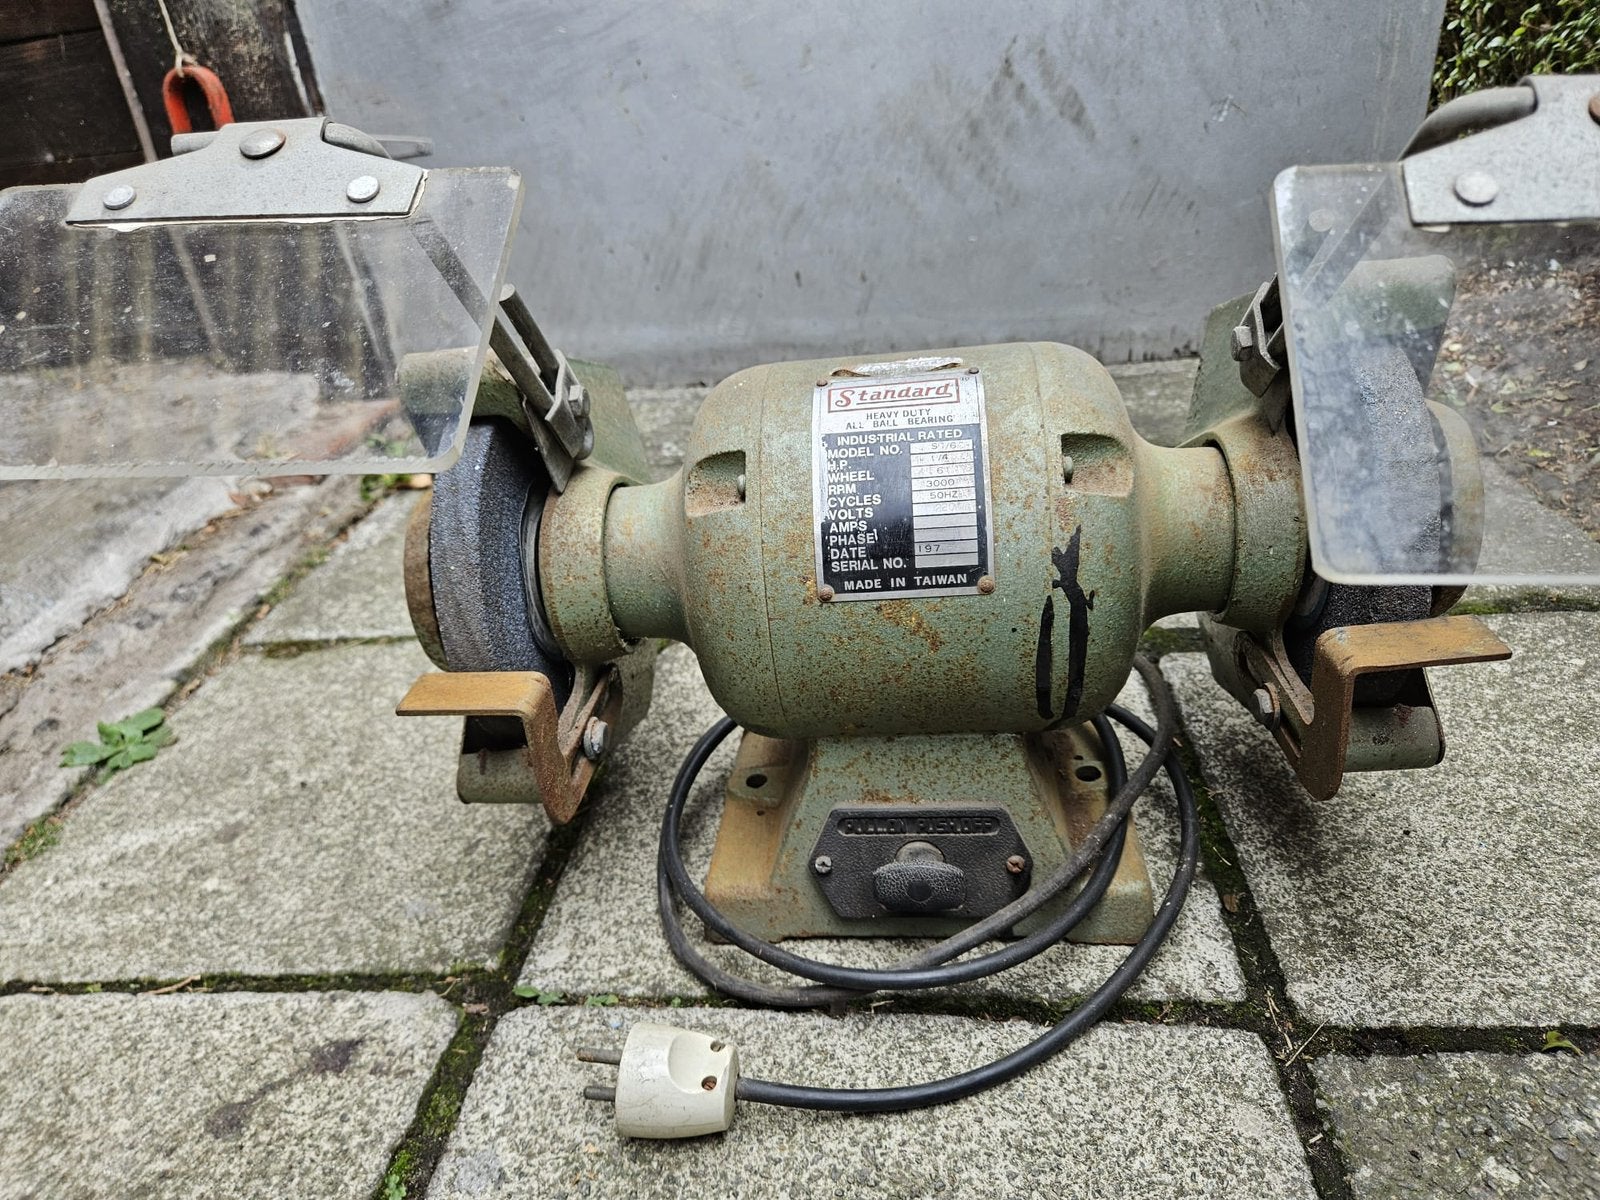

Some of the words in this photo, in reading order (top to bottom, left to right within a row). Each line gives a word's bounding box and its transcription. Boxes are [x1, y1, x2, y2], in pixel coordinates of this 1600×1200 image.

[835, 383, 953, 407] Standard
[866, 411, 899, 420] HEAVY
[903, 408, 931, 418] DUTY
[846, 421, 864, 430] ALL
[873, 419, 898, 428] BALL
[908, 415, 953, 425] BEARING
[837, 431, 915, 445] INDUSTRIAL
[918, 429, 963, 440] RATED
[827, 447, 874, 459] MODEL
[880, 444, 903, 455] NO.
[828, 459, 852, 470] H.P.
[828, 470, 875, 483] WHEEL
[828, 483, 857, 495] RPM
[926, 478, 955, 488] 3000
[828, 494, 882, 508] CYCLES
[828, 507, 874, 520] VOLTS
[829, 520, 868, 533] AMPS
[829, 533, 875, 546] PHASE
[830, 546, 867, 560] DATE
[919, 544, 940, 553] 197
[831, 559, 878, 573] SERIAL
[883, 557, 907, 569] NO.
[844, 579, 882, 591] MADE
[890, 576, 906, 588] IN
[914, 573, 968, 586] TAIWAN
